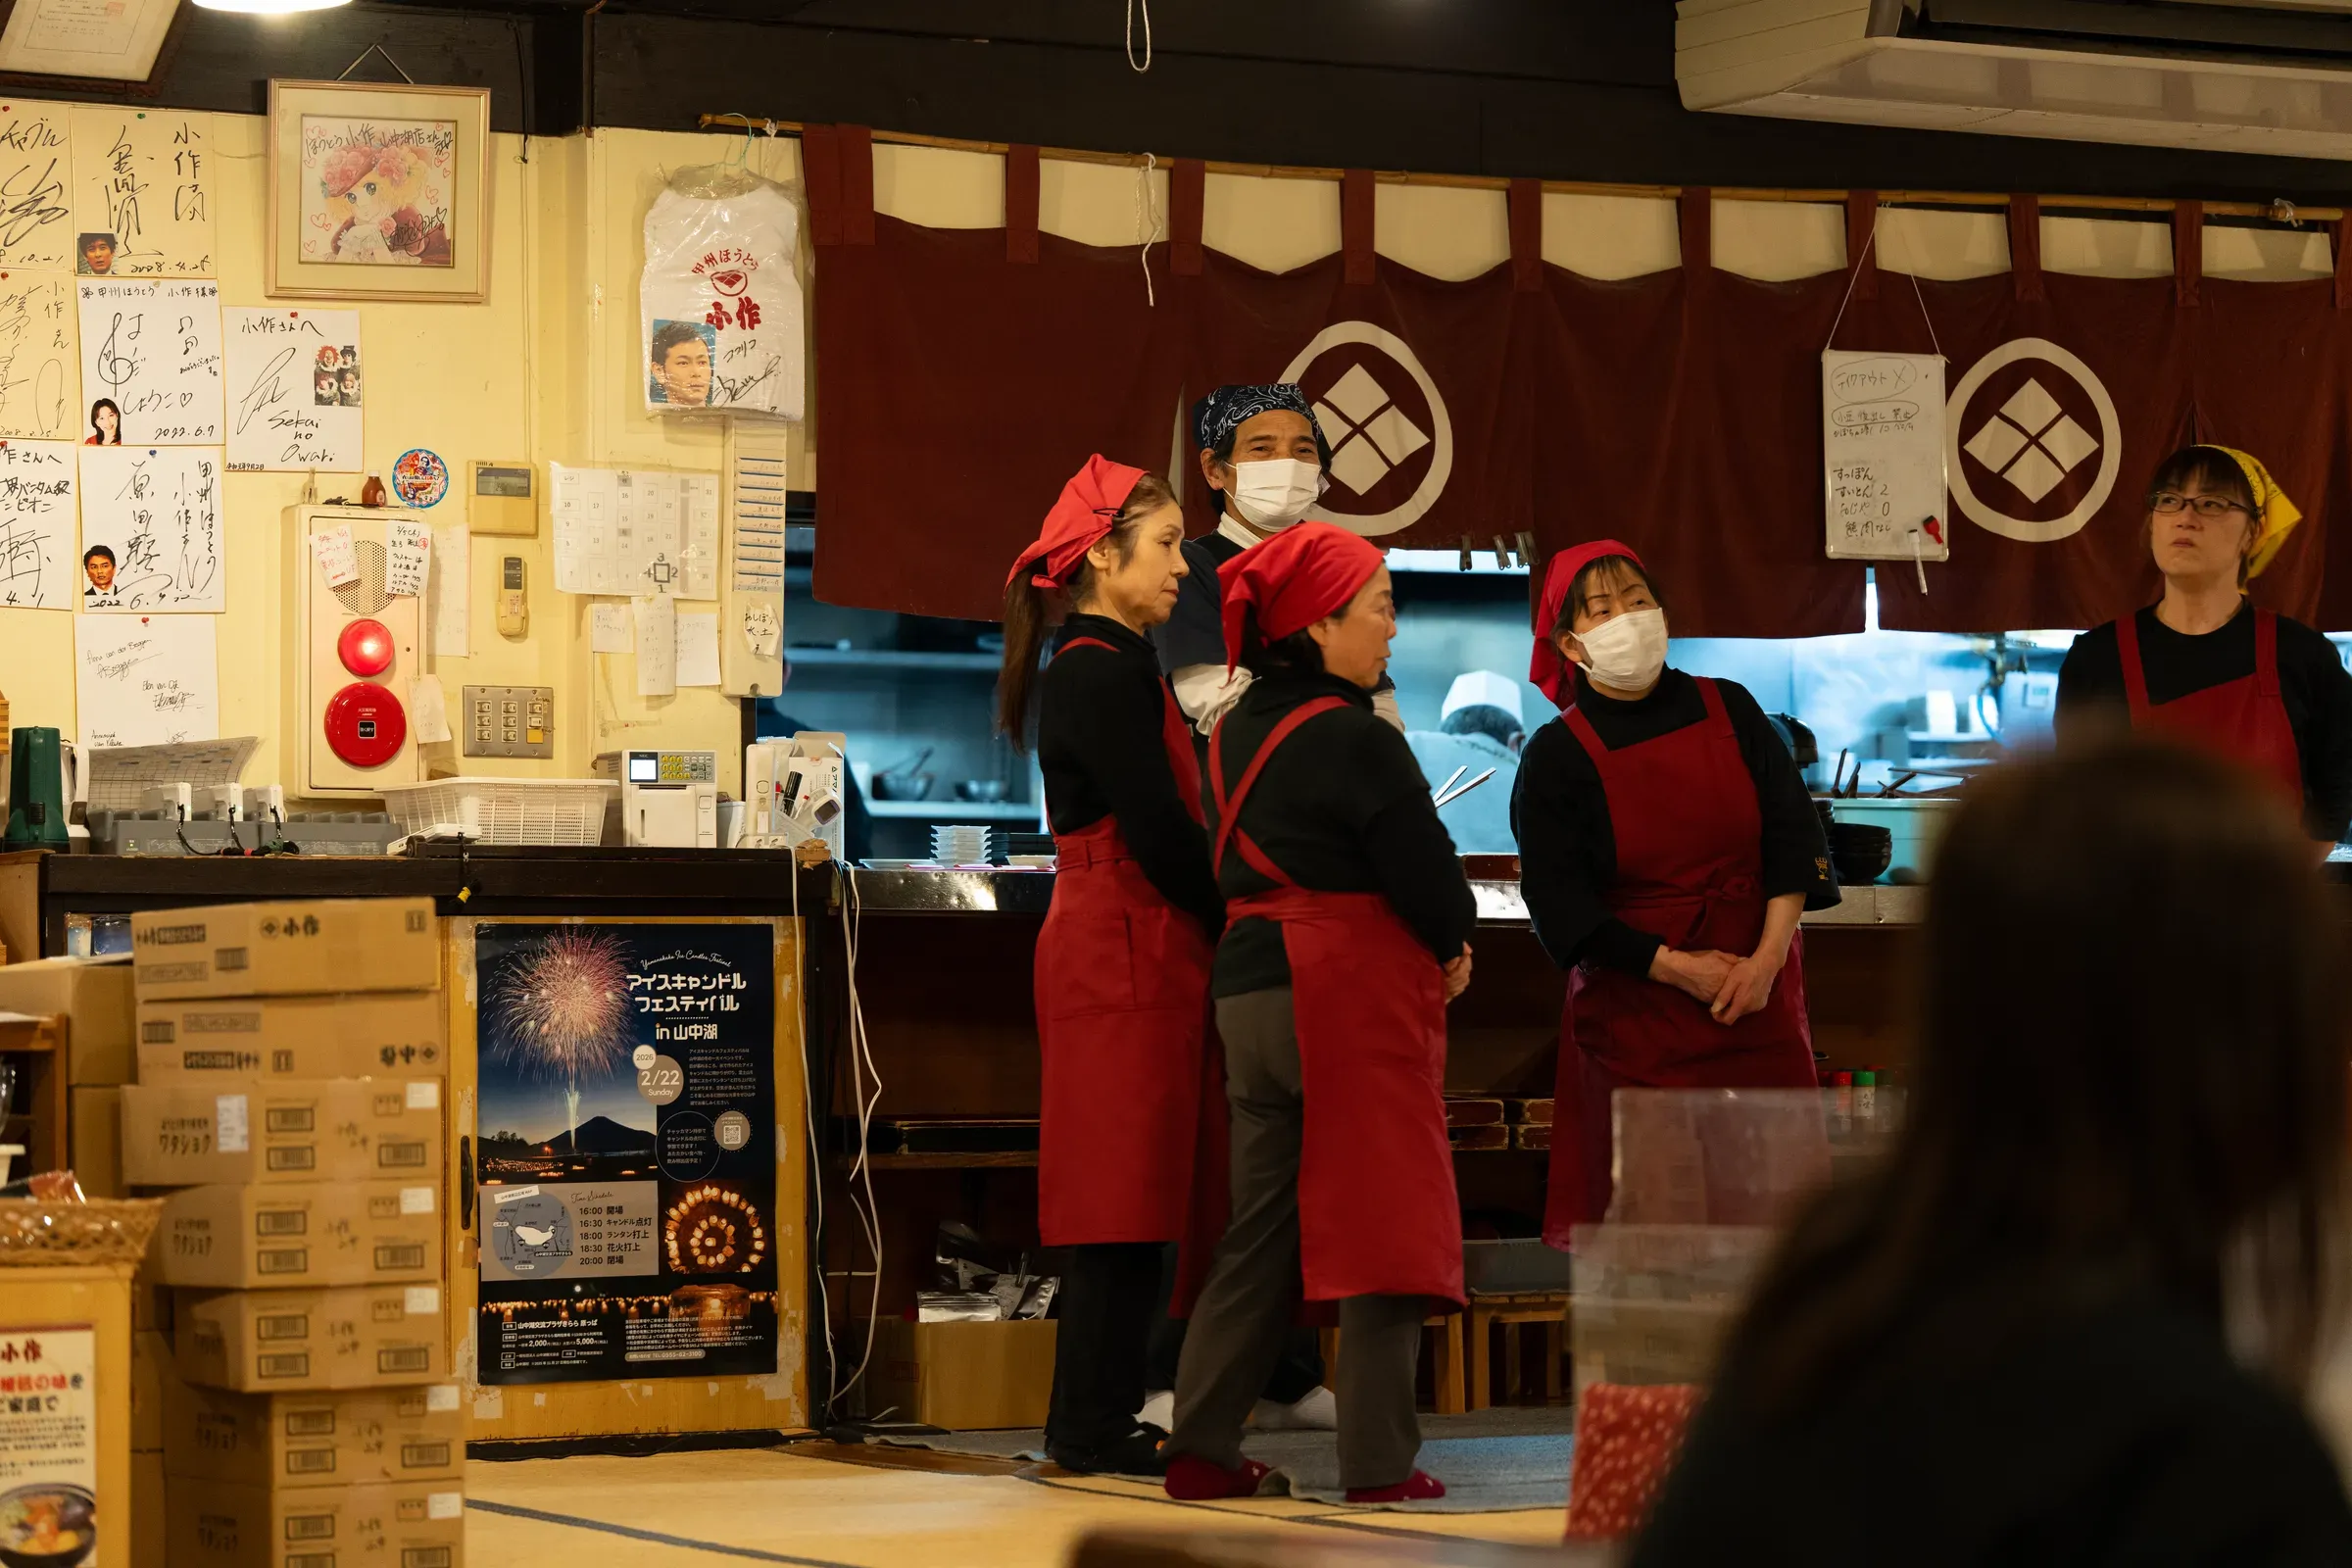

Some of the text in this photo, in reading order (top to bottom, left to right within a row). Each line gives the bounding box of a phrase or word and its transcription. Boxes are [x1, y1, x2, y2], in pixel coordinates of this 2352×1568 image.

[691, 247, 760, 275] 甲州ほうとう
[706, 296, 762, 331] 小作
[268, 410, 321, 430] Sekai
[281, 444, 335, 463] Owari
[0, 475, 72, 500] 界バンタム級
[657, 553, 665, 563] 3
[643, 566, 678, 578] 4 2
[658, 583, 666, 594] 1
[626, 972, 747, 991] アイスキャンドル
[634, 994, 740, 1012] フェスティバル
[655, 1022, 718, 1041] in 山中湖
[640, 1069, 680, 1086] 2/22
[648, 1088, 673, 1098] Sunday
[606, 1205, 624, 1215] 開場
[579, 1217, 653, 1228] 16:30 キャンドル点灯
[579, 1230, 650, 1241] 18:00 ランタン打上
[580, 1242, 642, 1252] 18:30 花火打上
[579, 1254, 624, 1265] 20:00 閉場
